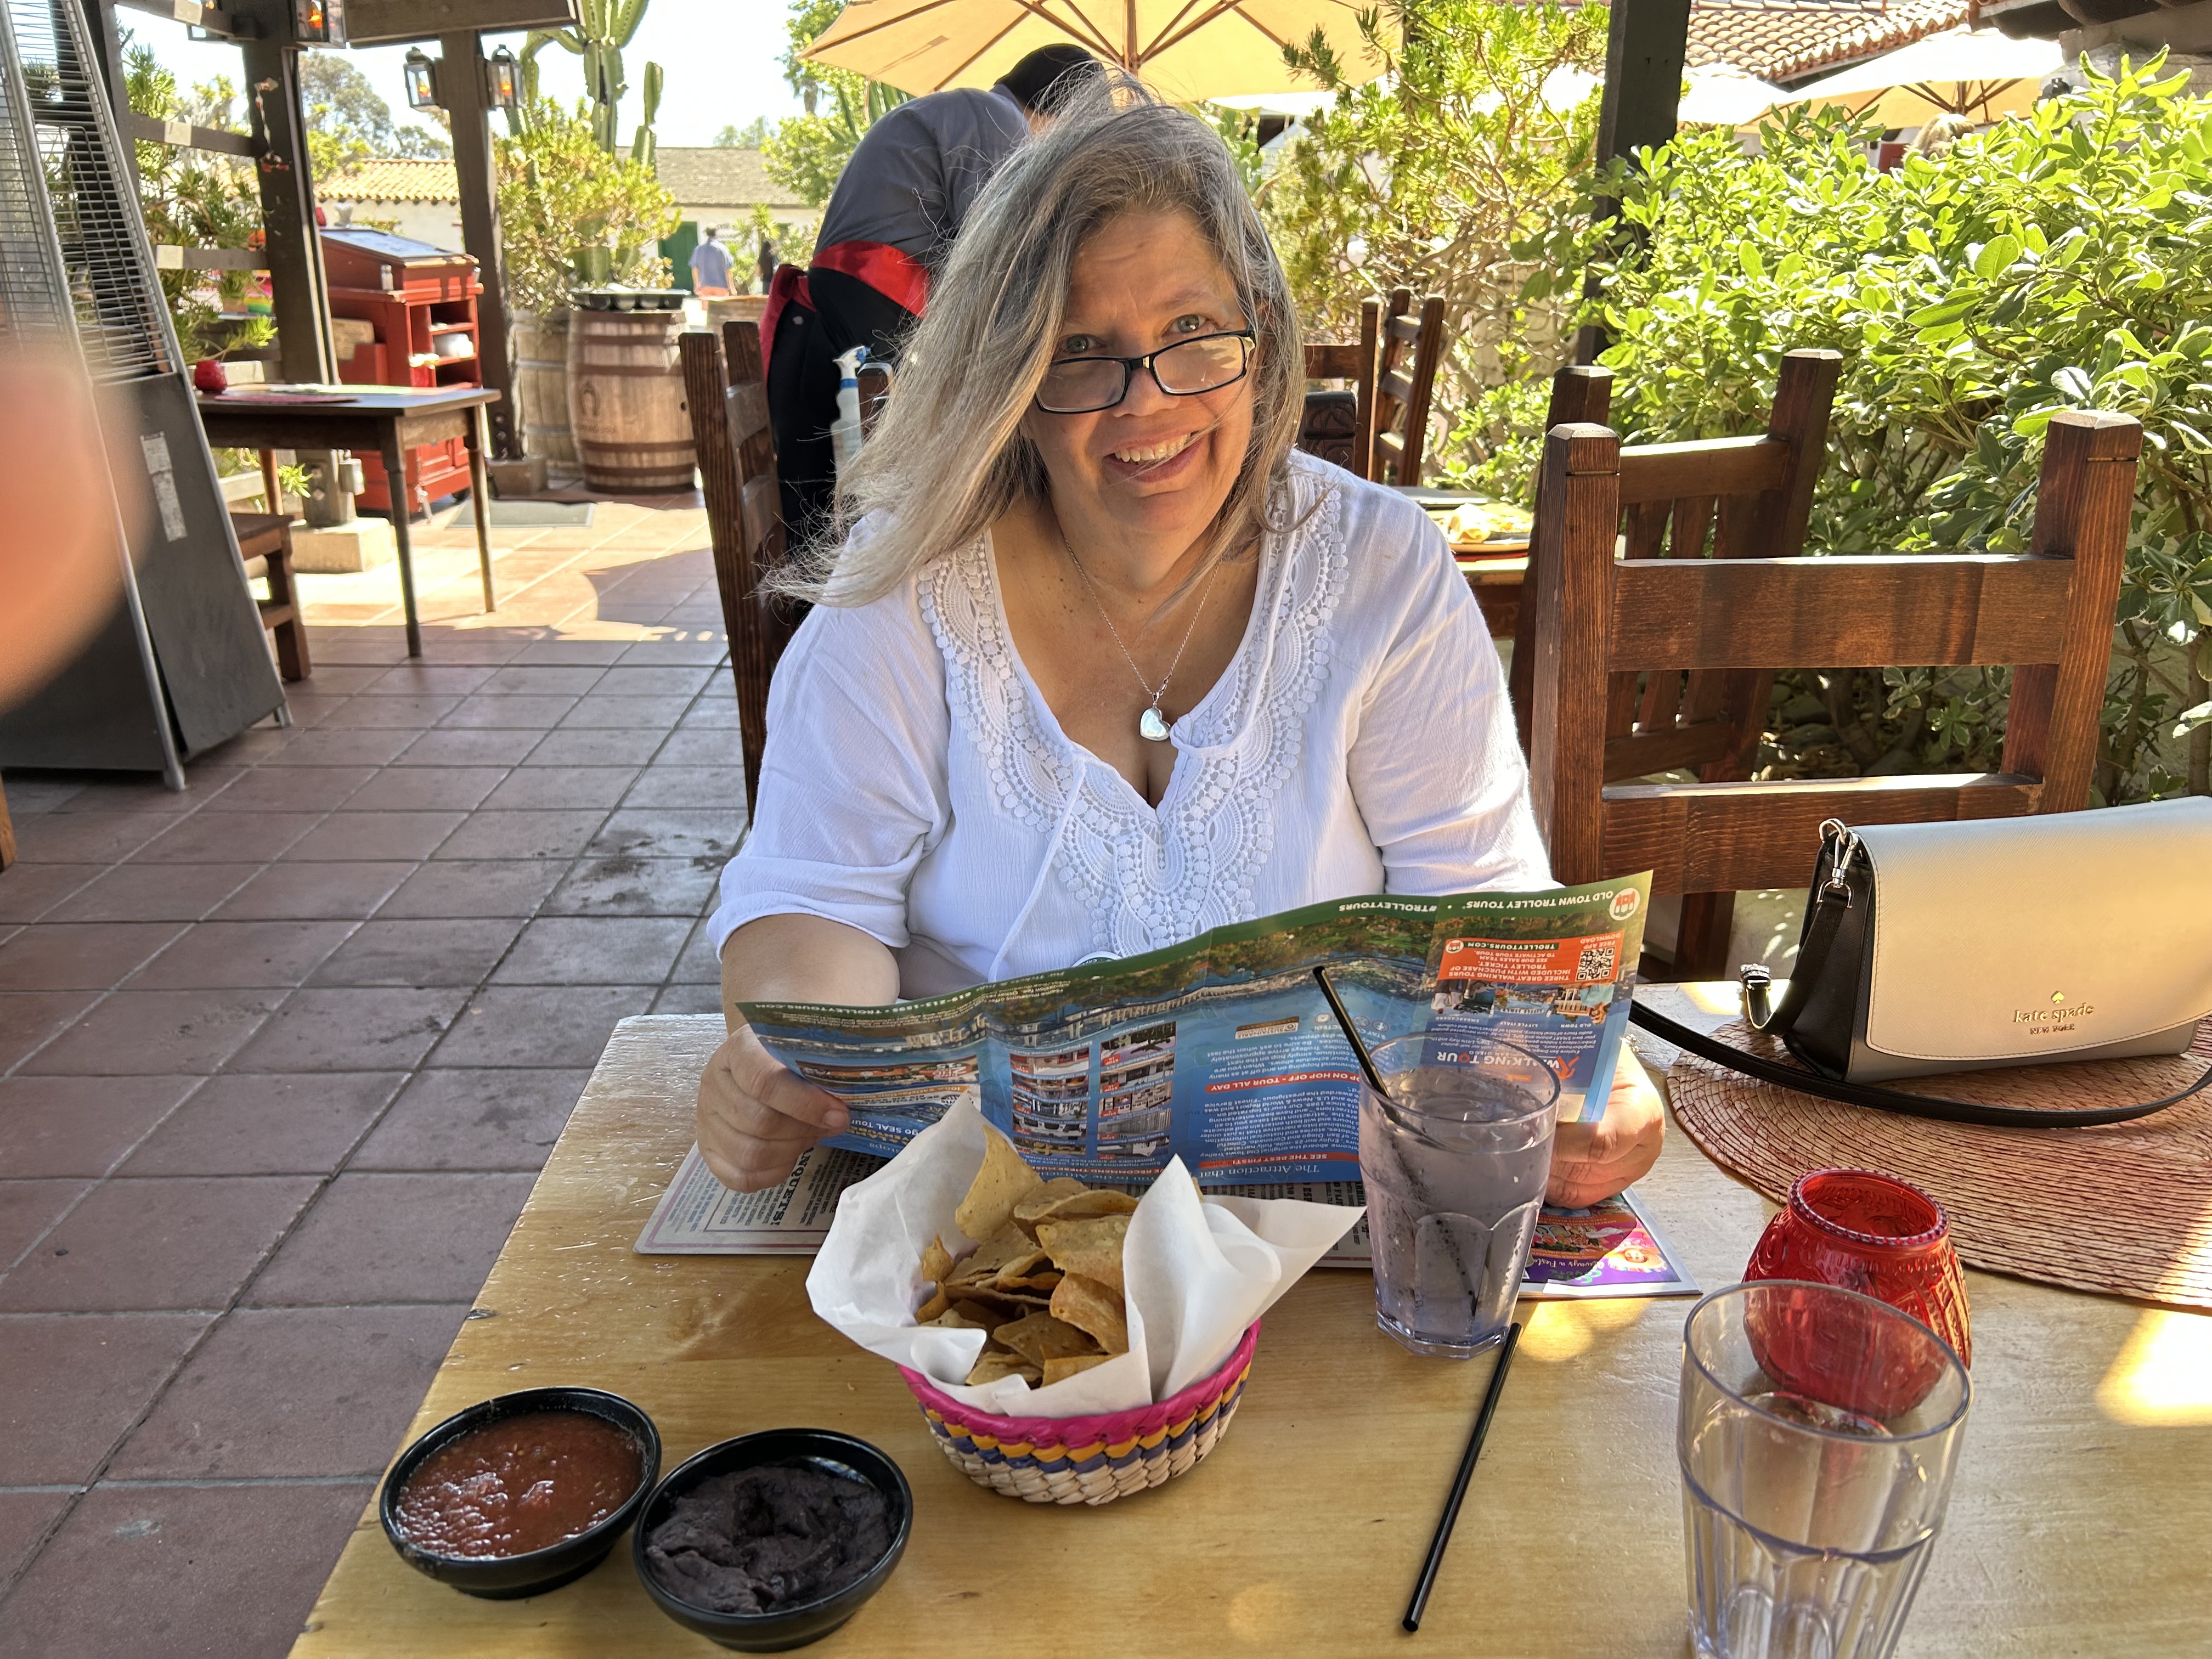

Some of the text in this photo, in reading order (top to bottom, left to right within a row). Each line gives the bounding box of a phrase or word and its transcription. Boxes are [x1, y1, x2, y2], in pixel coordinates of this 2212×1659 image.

[1466, 891, 1613, 909] OLD TOWN TROLLEY TOURS
[1339, 902, 1437, 912] #TROLLEYTOURS
[1580, 933, 1620, 944] DOWNLOAD
[1467, 942, 1555, 950] TROLLEYTOURS.COM
[1463, 966, 1505, 974] PURCHASE
[2013, 1002, 2095, 1023] kate spade
[2052, 1024, 2074, 1032] YORK
[1437, 1052, 1479, 1064] TOUR
[1253, 1077, 1279, 1086] TOUR
[851, 1120, 901, 1133] SEAL Tour
[1250, 1121, 1284, 1130] entertain
[1229, 1165, 1291, 1175] Attraction
[1295, 1165, 1319, 1173] The
[770, 1148, 814, 1225] ANQUETS!
